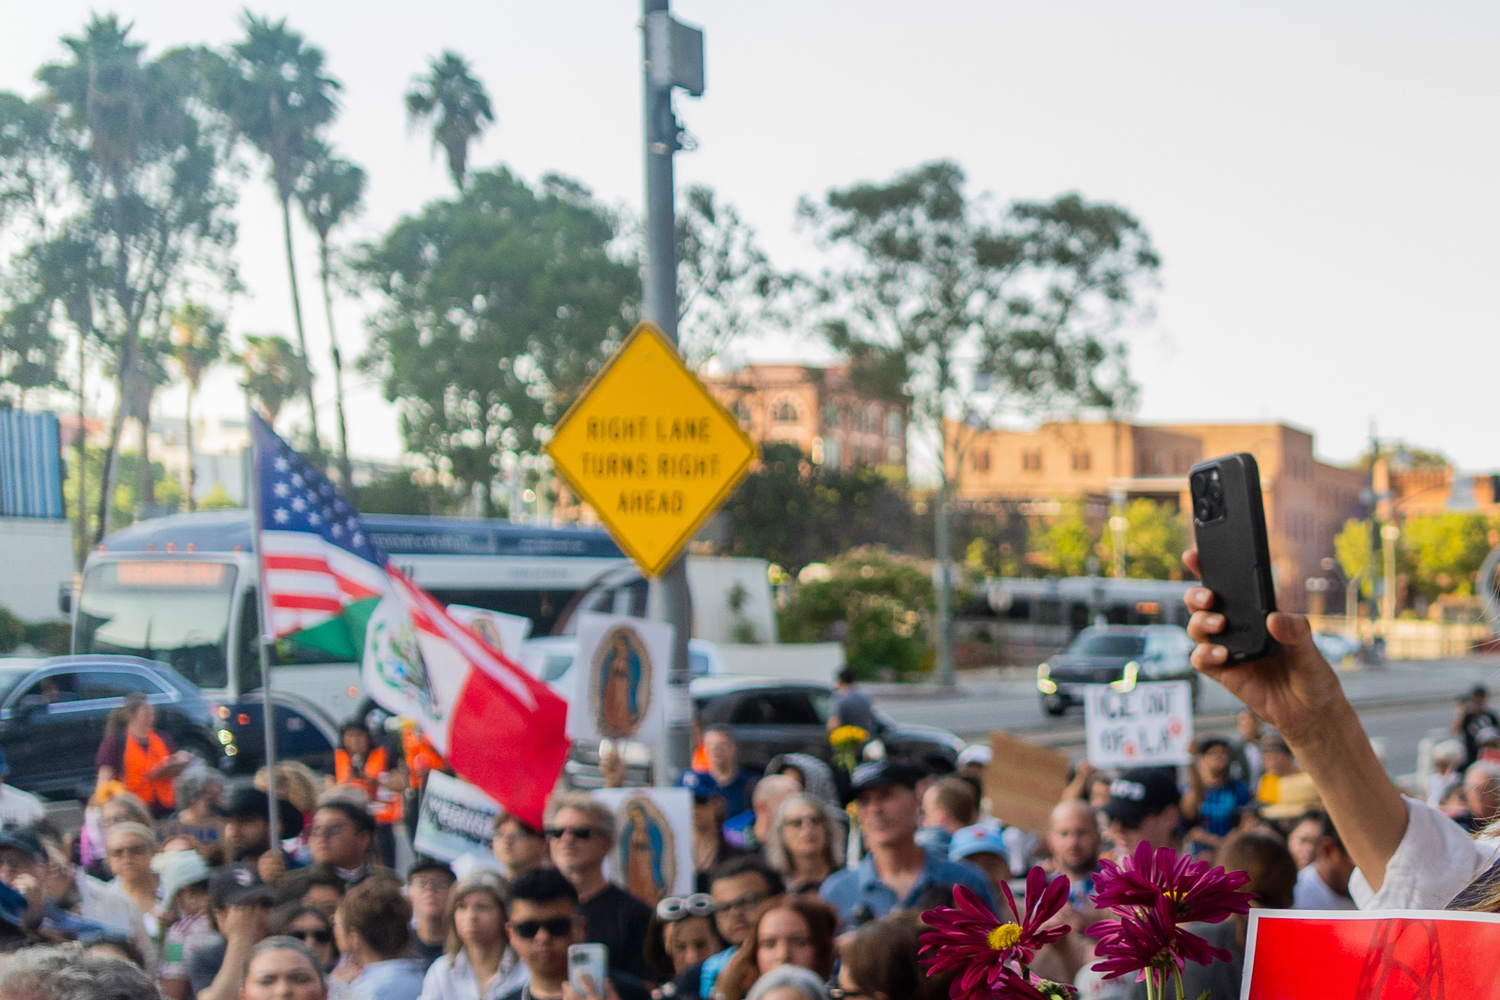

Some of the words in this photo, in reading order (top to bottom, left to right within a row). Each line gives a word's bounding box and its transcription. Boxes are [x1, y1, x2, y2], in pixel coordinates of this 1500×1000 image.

[586, 416, 648, 441] RIGHT
[656, 417, 711, 442] LANE
[582, 452, 648, 478] TURNS
[657, 453, 720, 478] RIGHT
[616, 489, 684, 514] AHEAD
